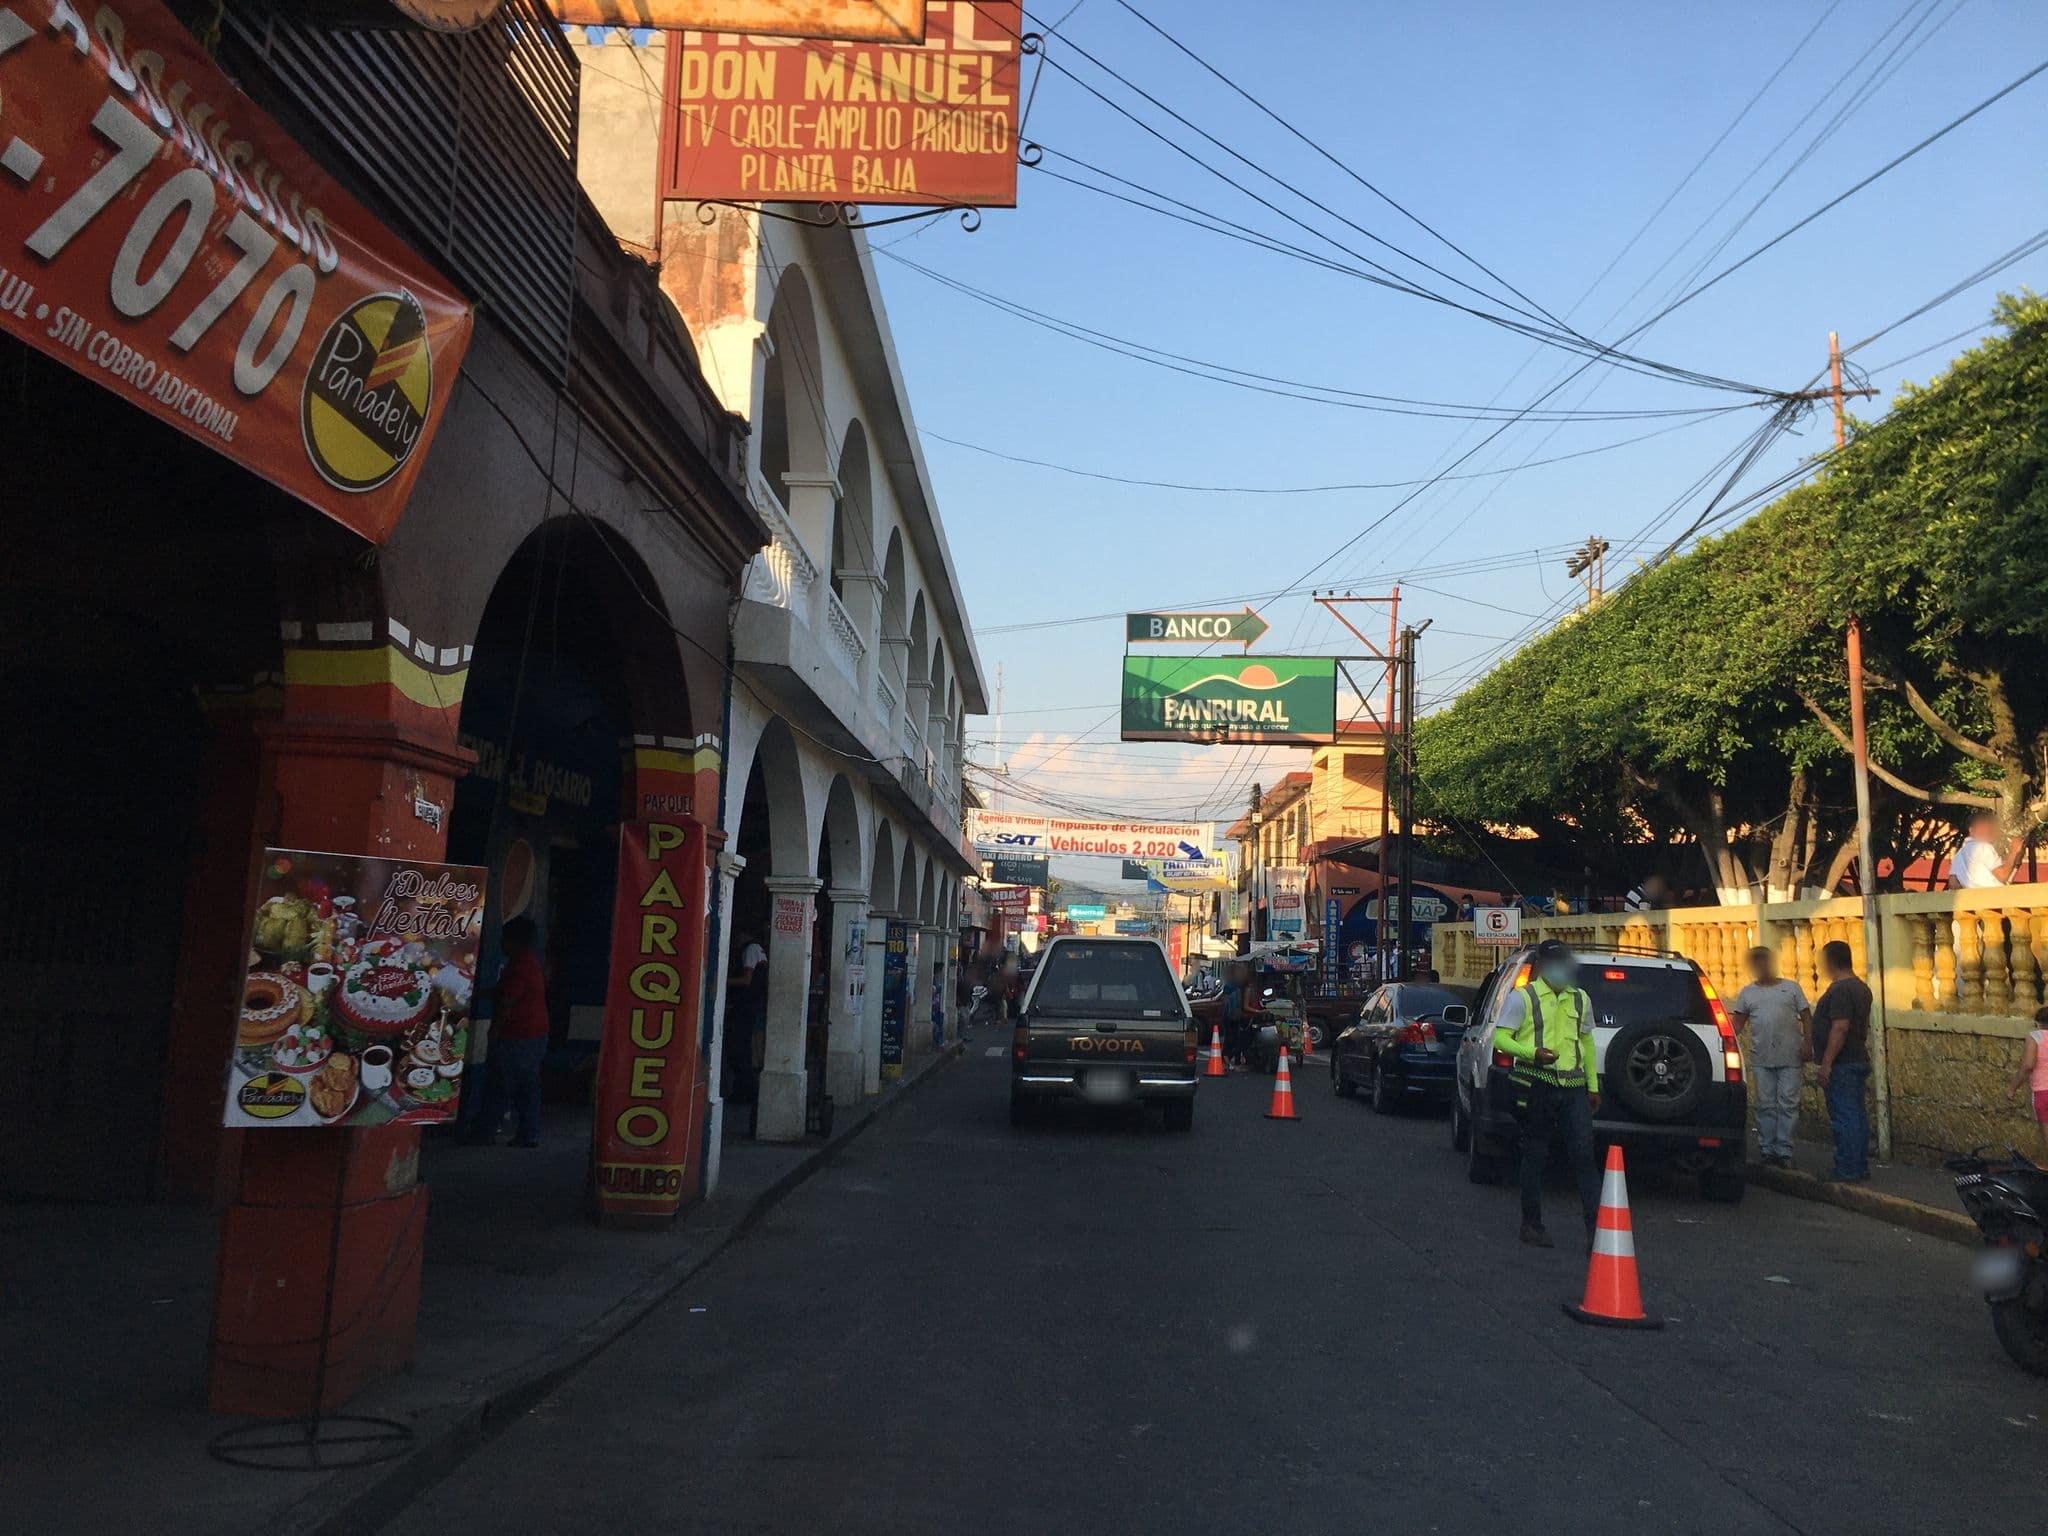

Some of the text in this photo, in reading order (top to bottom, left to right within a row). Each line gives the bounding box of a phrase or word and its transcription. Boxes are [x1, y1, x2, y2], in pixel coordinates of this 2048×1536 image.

[681, 50, 1010, 105] DON MANUEL
[680, 104, 1009, 154] TV CABLE-AMPLIO PARQUEO
[740, 154, 917, 195] PLANTA BAJA
[0, 266, 239, 442] UL SIN COBRO ADICIONAL
[319, 322, 418, 462] Panadely
[1150, 617, 1232, 638] BANCO
[1164, 699, 1290, 722] BANRURAL
[1175, 721, 1200, 731] amigo
[1229, 722, 1253, 731] ayuda
[534, 760, 592, 806] ROSARIO
[977, 813, 1045, 826] Agencia Virtual
[1050, 820, 1200, 836] Impuesto de Circulación
[994, 832, 1042, 846] SAT
[1050, 835, 1176, 859] Vehículos 2,020
[367, 897, 479, 941] fiestas!
[616, 823, 686, 1147] PARQUEO
[1067, 1037, 1144, 1052] TOYOTA
